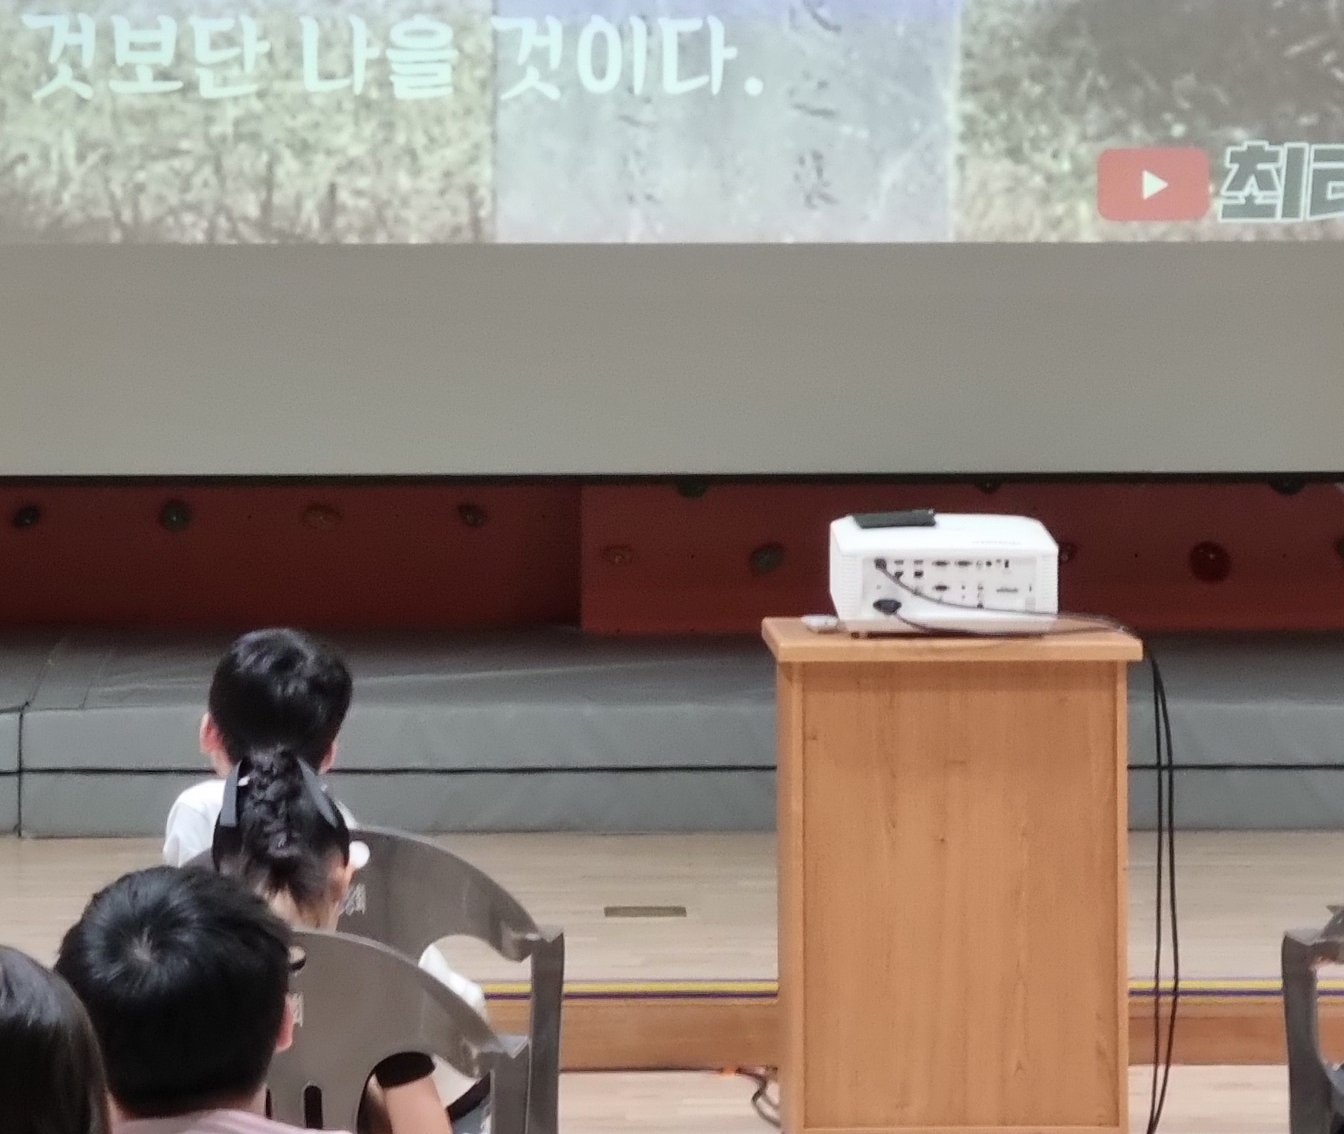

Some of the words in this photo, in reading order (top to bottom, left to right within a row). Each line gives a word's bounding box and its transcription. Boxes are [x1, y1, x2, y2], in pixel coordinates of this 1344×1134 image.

[20, 13, 272, 101] 것보단
[299, 14, 457, 101] 나을
[490, 14, 763, 101] 것이다.
